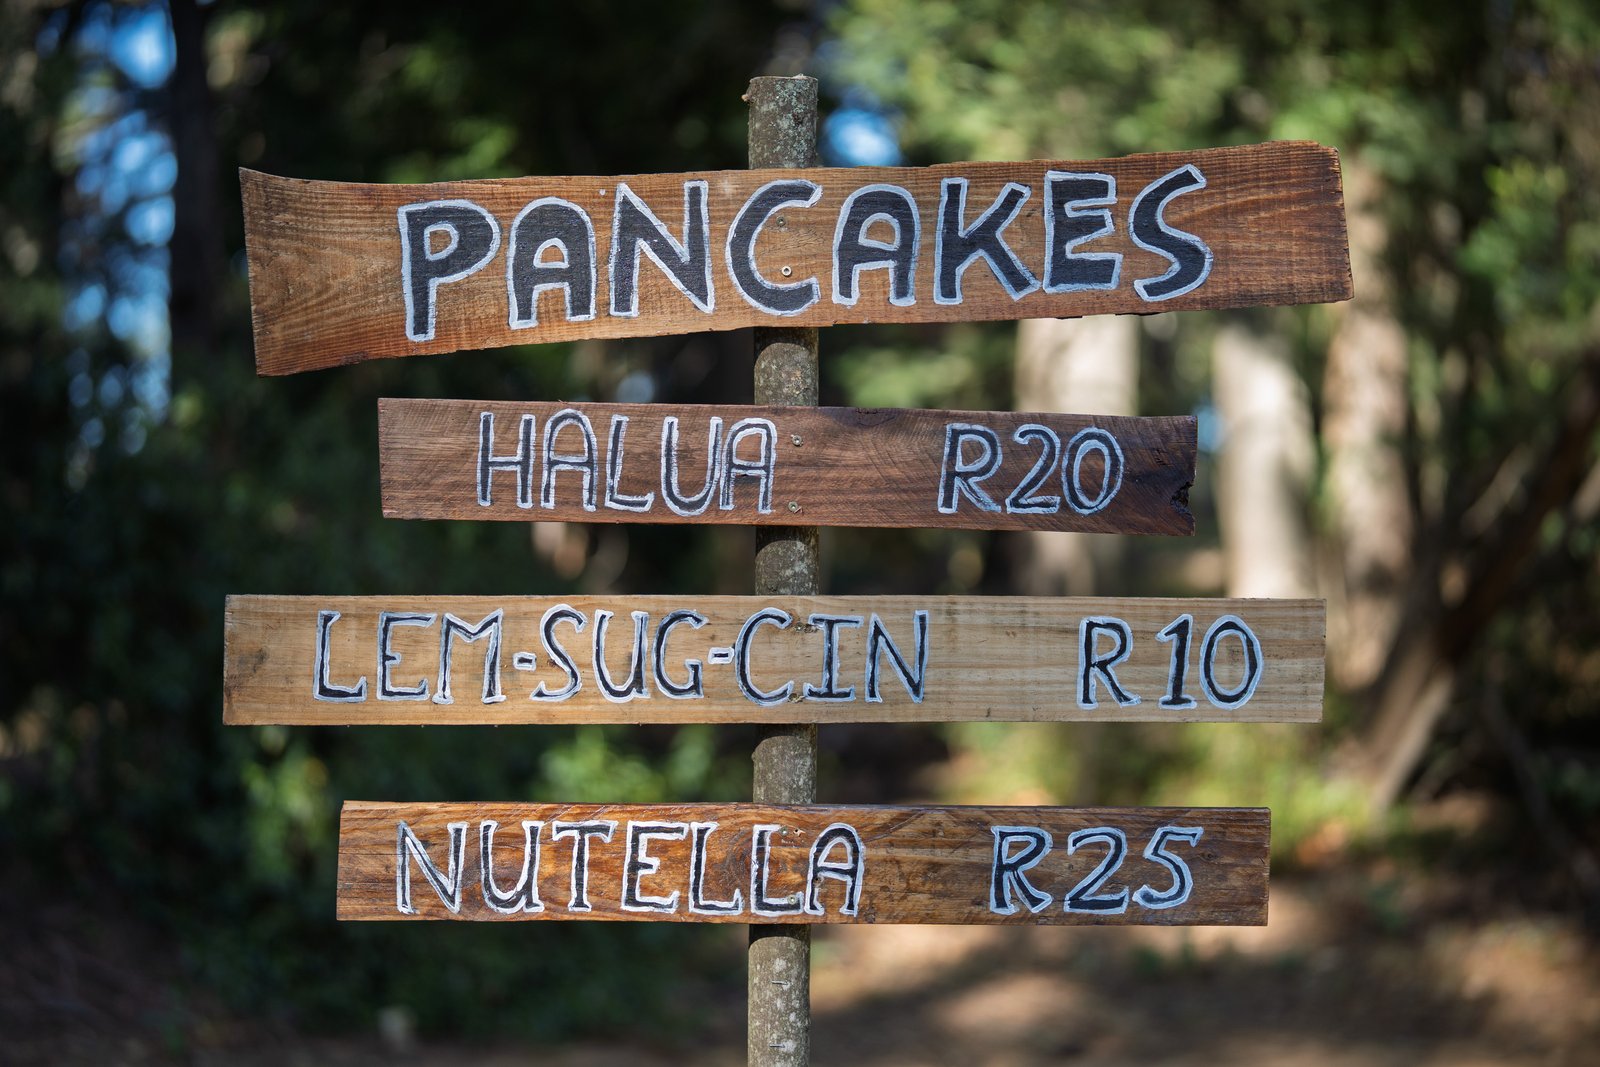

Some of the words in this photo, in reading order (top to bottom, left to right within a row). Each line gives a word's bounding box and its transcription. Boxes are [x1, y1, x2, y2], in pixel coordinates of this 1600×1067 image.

[397, 164, 1213, 342] PANCAKES
[477, 409, 777, 516] HALUA
[938, 423, 1124, 515] R20
[313, 604, 929, 706] LEM-SUG-CIN
[1077, 614, 1263, 710] R10
[396, 820, 865, 917] NUTELLA
[990, 826, 1204, 915] R25
